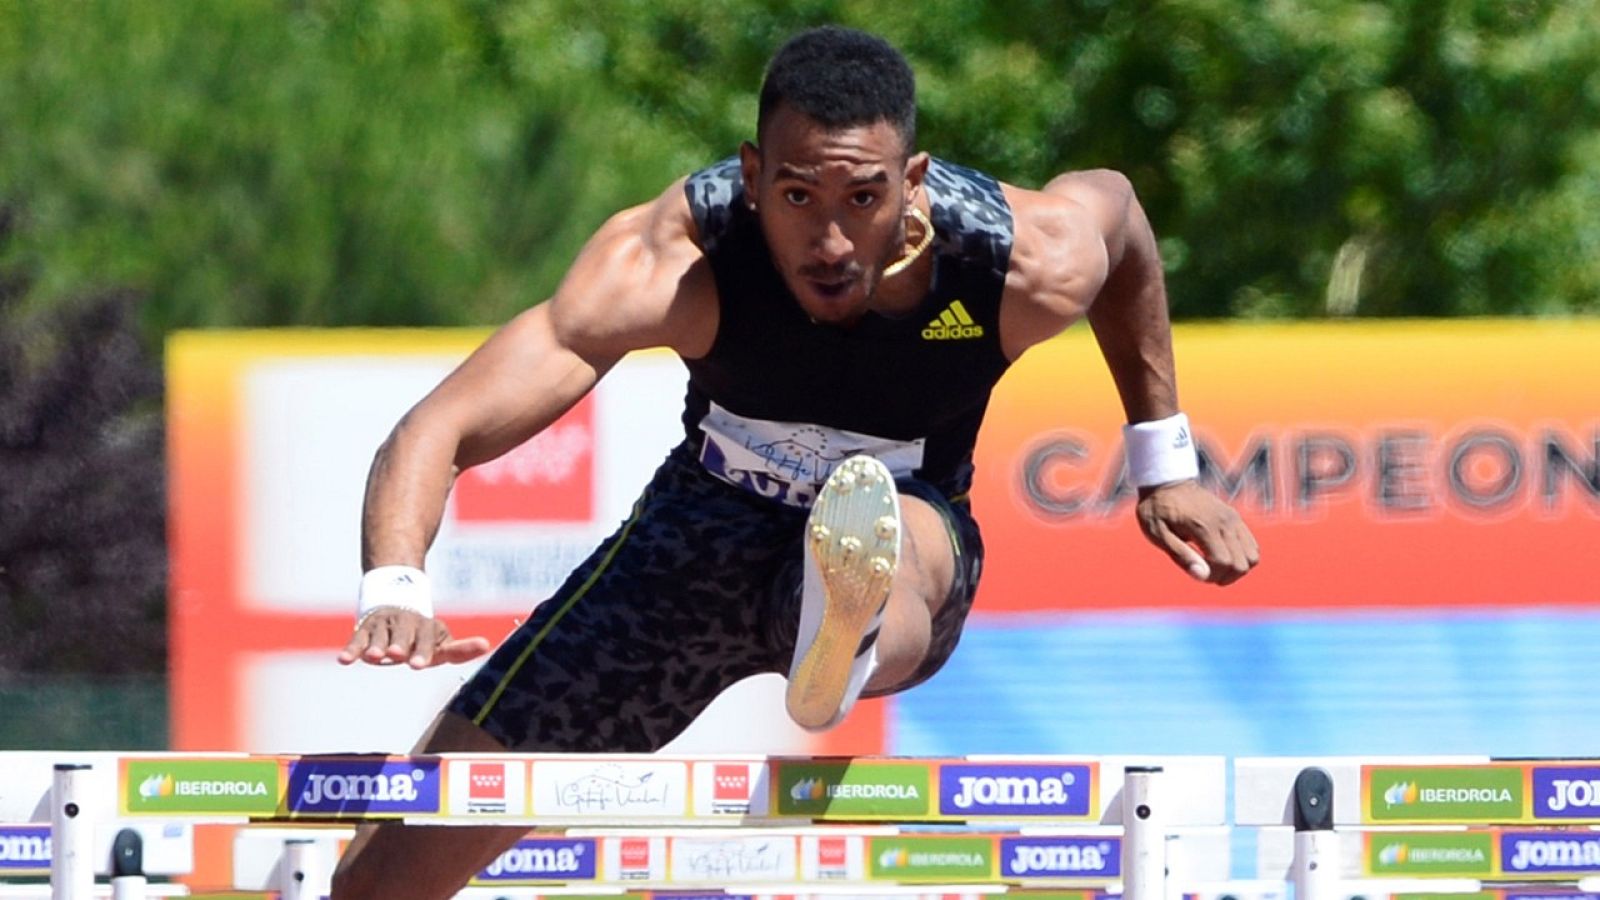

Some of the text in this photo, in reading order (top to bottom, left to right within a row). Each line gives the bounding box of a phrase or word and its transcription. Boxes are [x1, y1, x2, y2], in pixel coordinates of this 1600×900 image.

[921, 325, 984, 340] adidas
[175, 780, 267, 797] IBERDROLA
[827, 784, 919, 798] IBERDROLA
[1420, 788, 1512, 803] IBERDROLA
